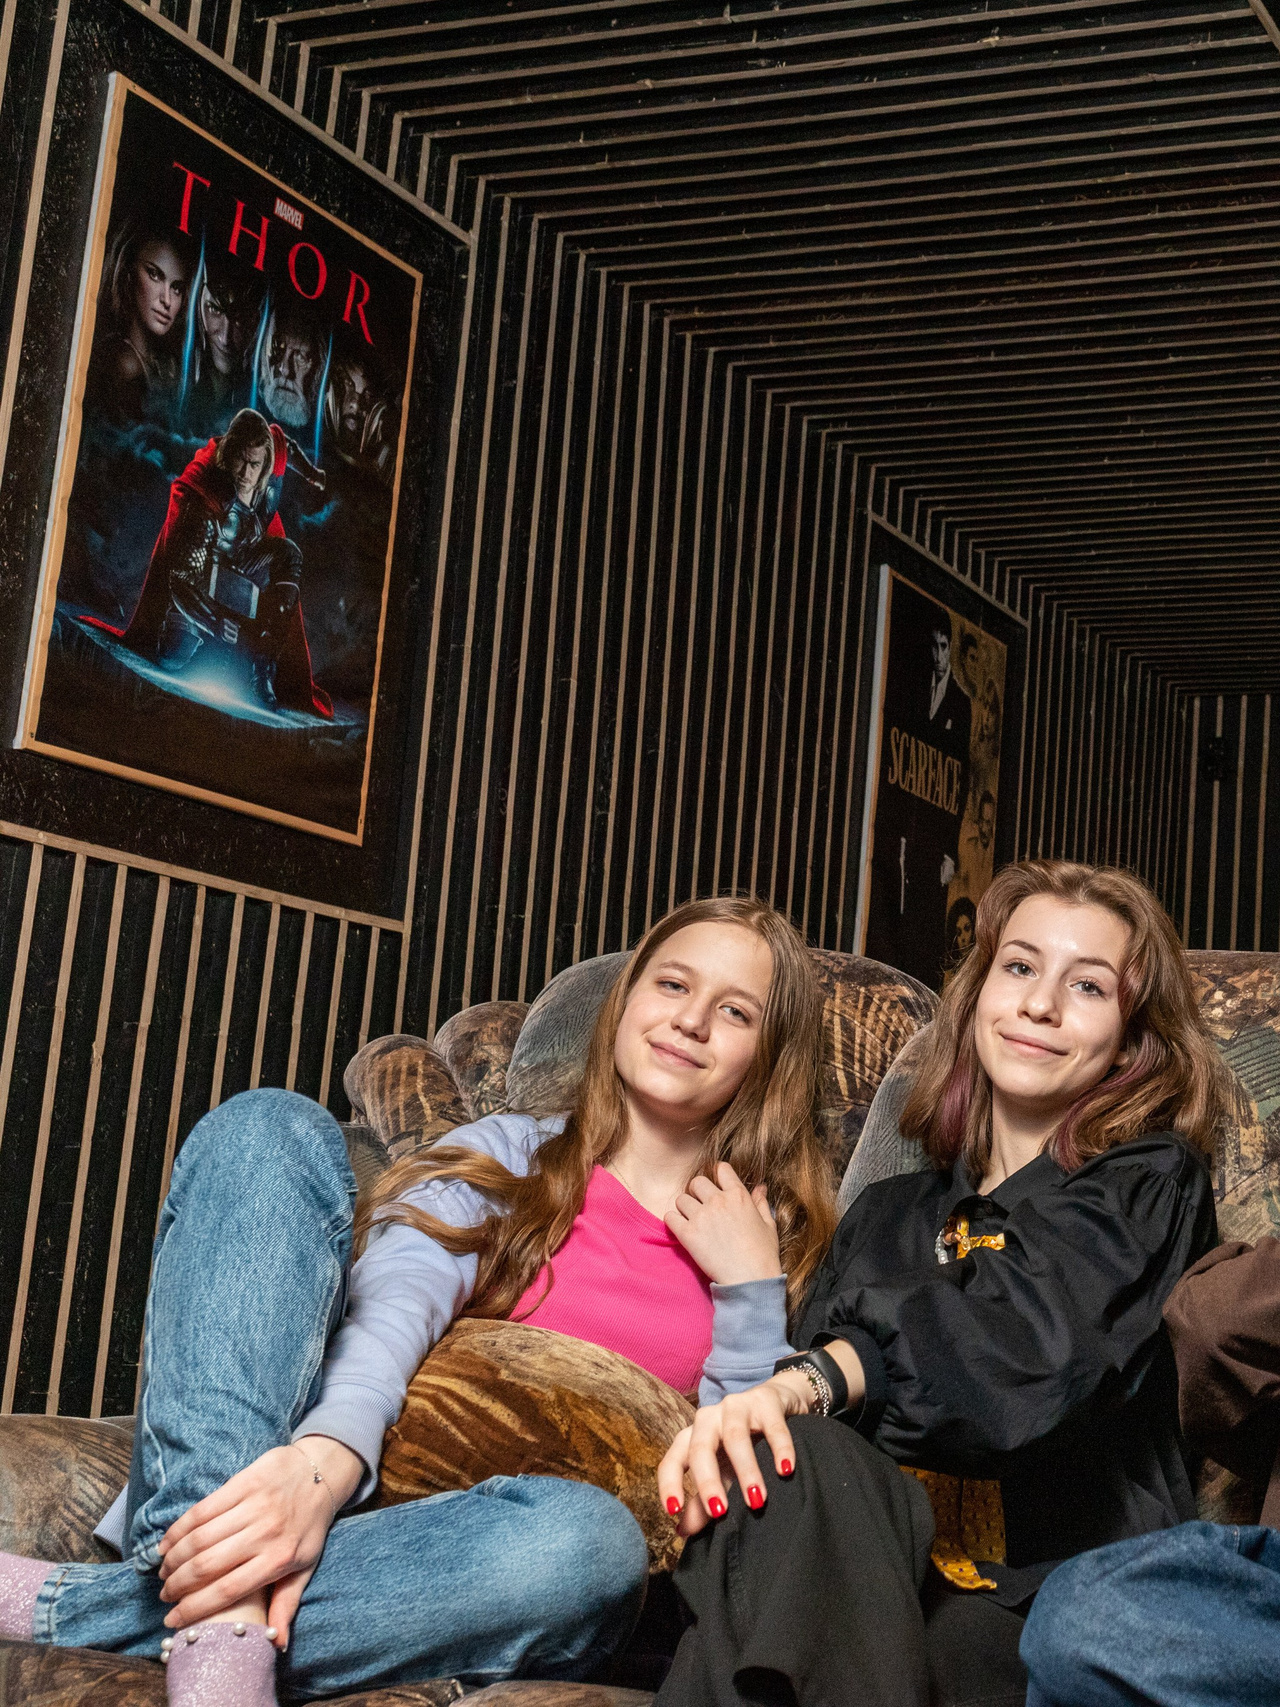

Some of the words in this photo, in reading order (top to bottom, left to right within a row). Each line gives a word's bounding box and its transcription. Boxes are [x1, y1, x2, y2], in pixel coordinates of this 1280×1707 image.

[172, 161, 374, 346] THOR
[274, 197, 304, 231] MARVEL
[887, 726, 961, 816] SCARFACE
